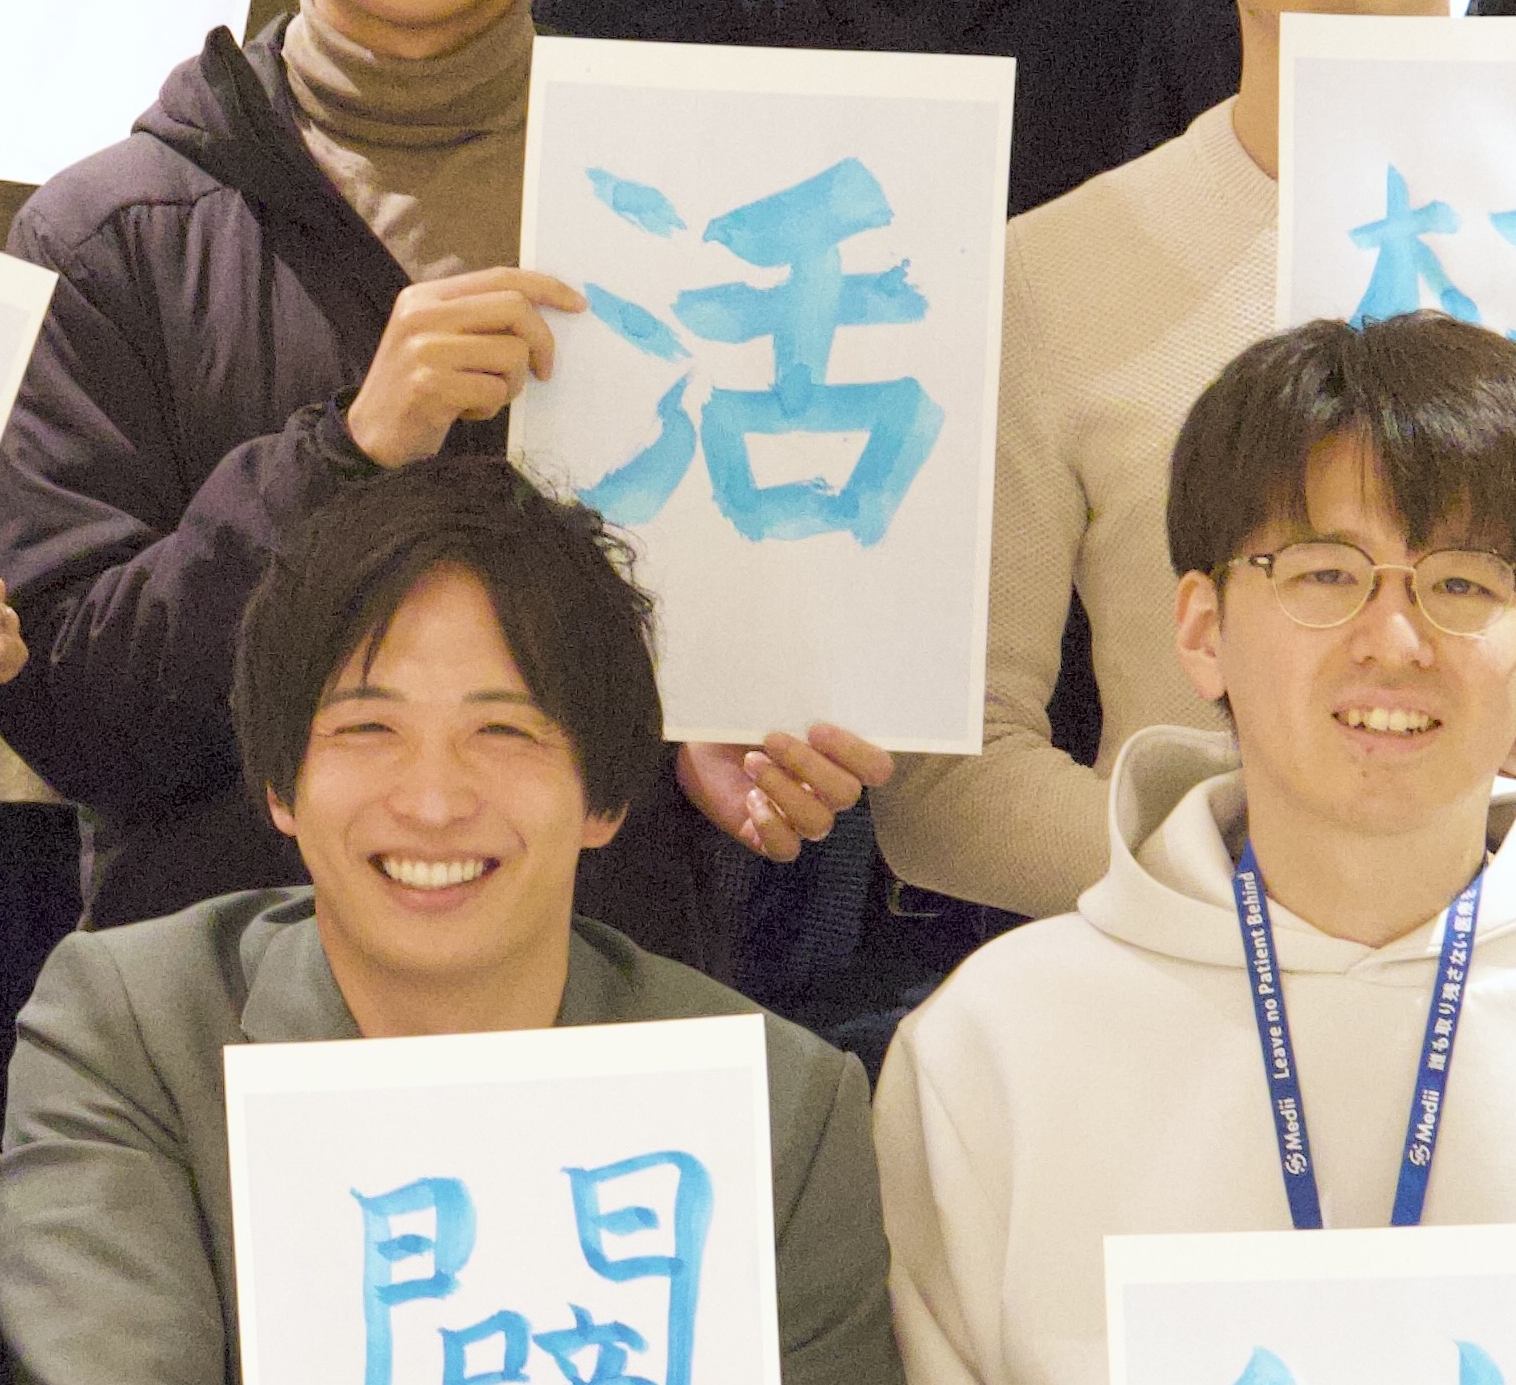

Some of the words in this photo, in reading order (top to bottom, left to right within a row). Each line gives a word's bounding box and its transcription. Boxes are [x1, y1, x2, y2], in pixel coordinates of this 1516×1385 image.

[570, 155, 948, 549] 活
[1237, 871, 1263, 926] Behind
[1251, 927, 1275, 995] Patient
[1264, 998, 1280, 1022] no
[1270, 1025, 1291, 1081] Leave
[1279, 1096, 1303, 1151] Medii
[1414, 1089, 1440, 1144] Medii
